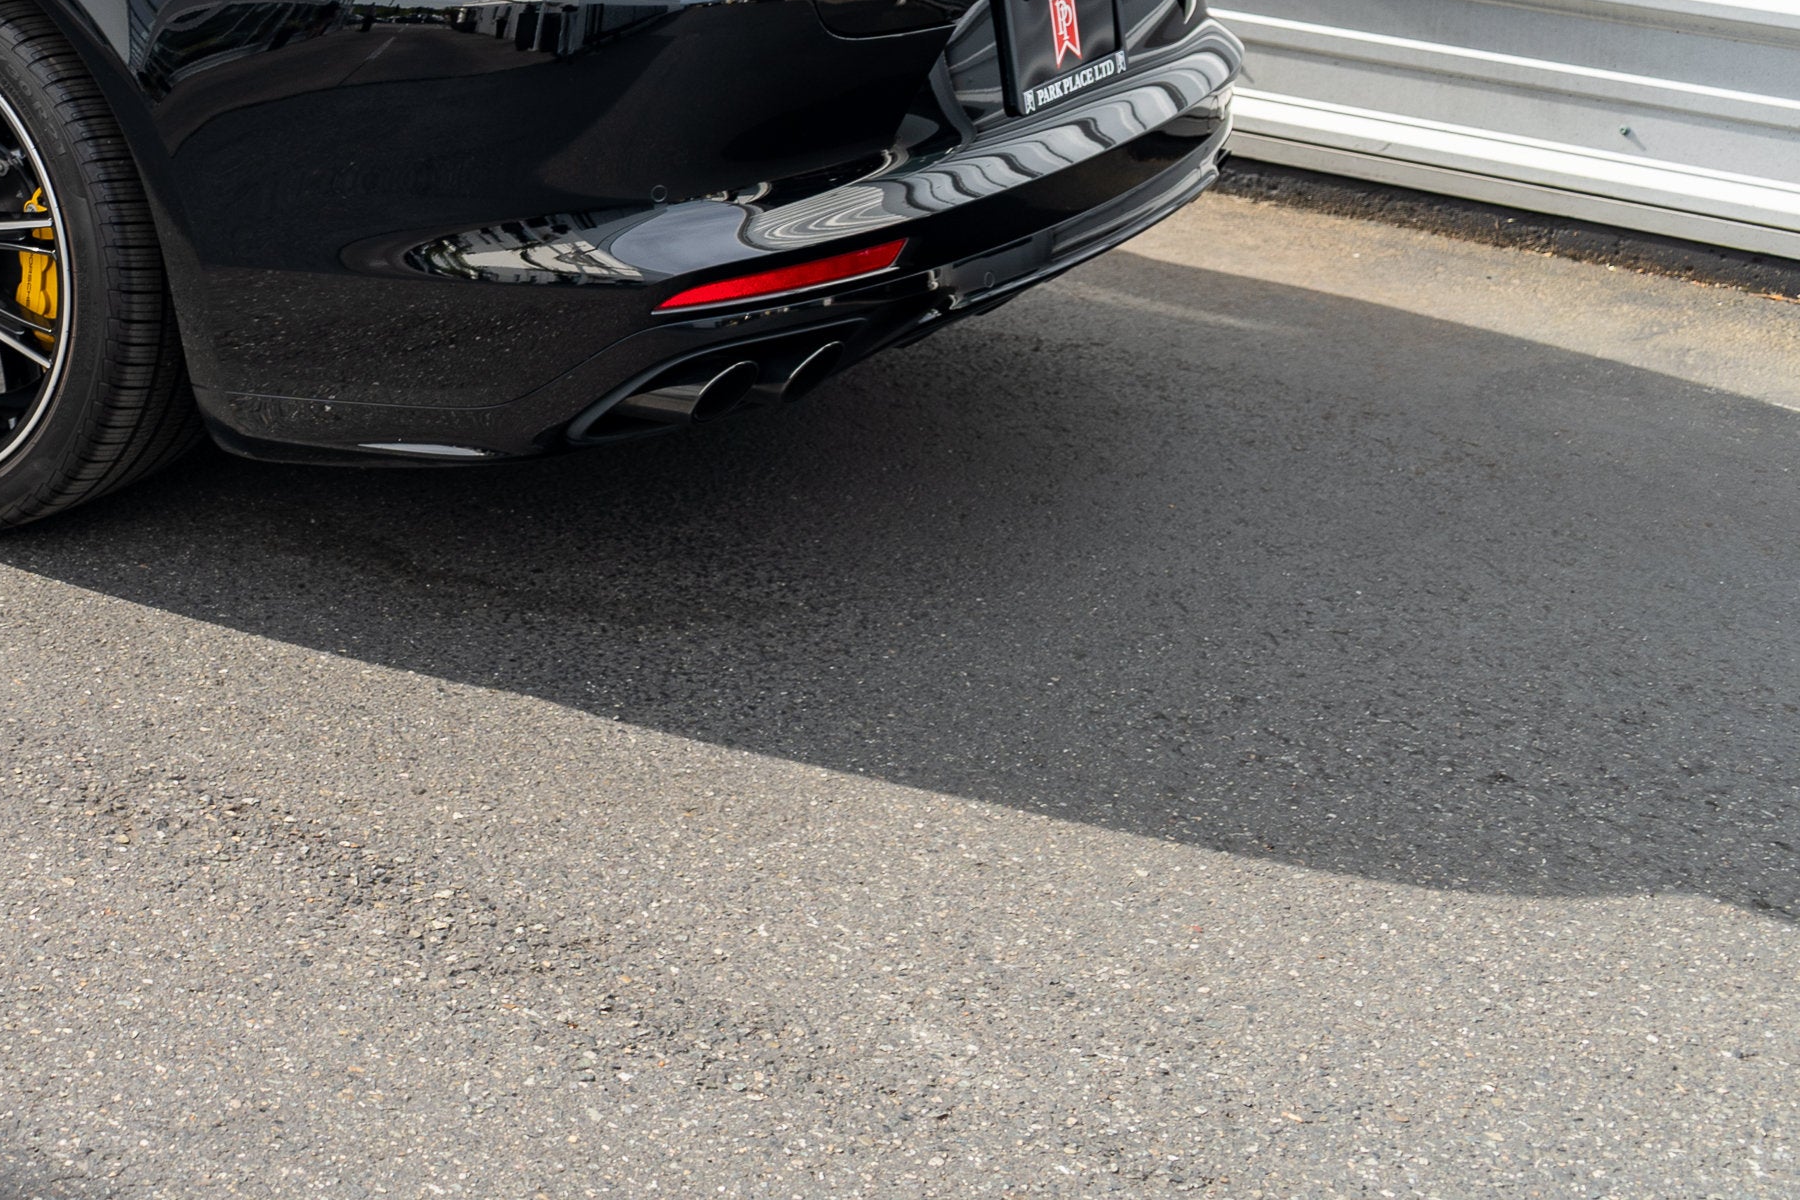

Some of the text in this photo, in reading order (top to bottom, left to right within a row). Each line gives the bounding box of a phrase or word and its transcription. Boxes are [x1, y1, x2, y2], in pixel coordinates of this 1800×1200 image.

[1036, 59, 1115, 106] PARK PLACE LTD
